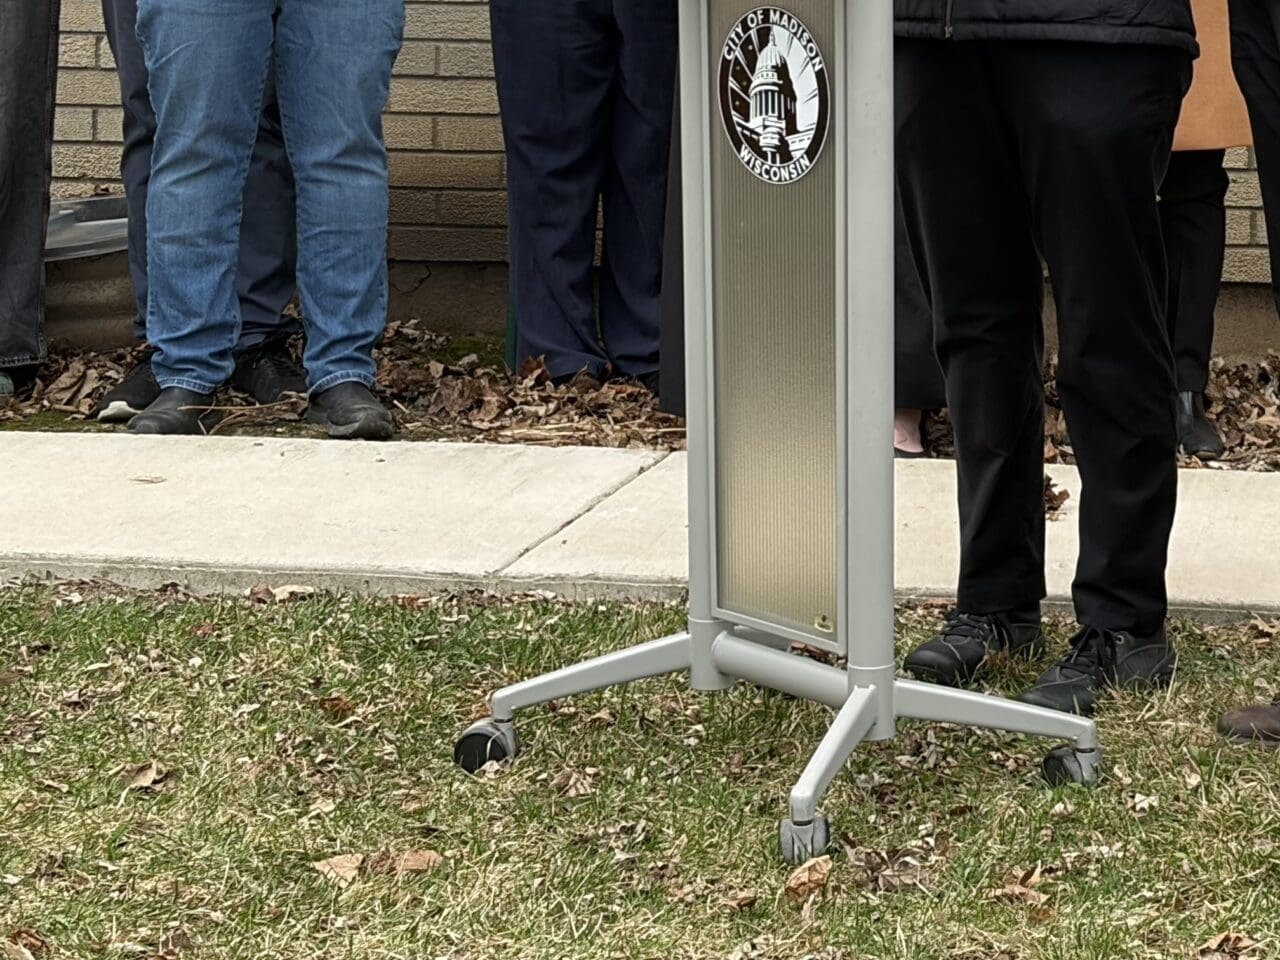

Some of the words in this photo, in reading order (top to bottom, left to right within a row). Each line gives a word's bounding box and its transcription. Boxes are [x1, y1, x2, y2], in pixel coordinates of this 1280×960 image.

[723, 27, 744, 60] CITY
[747, 10, 764, 25] OF
[769, 9, 823, 72] MADISON
[739, 143, 811, 181] WISCONSIN
